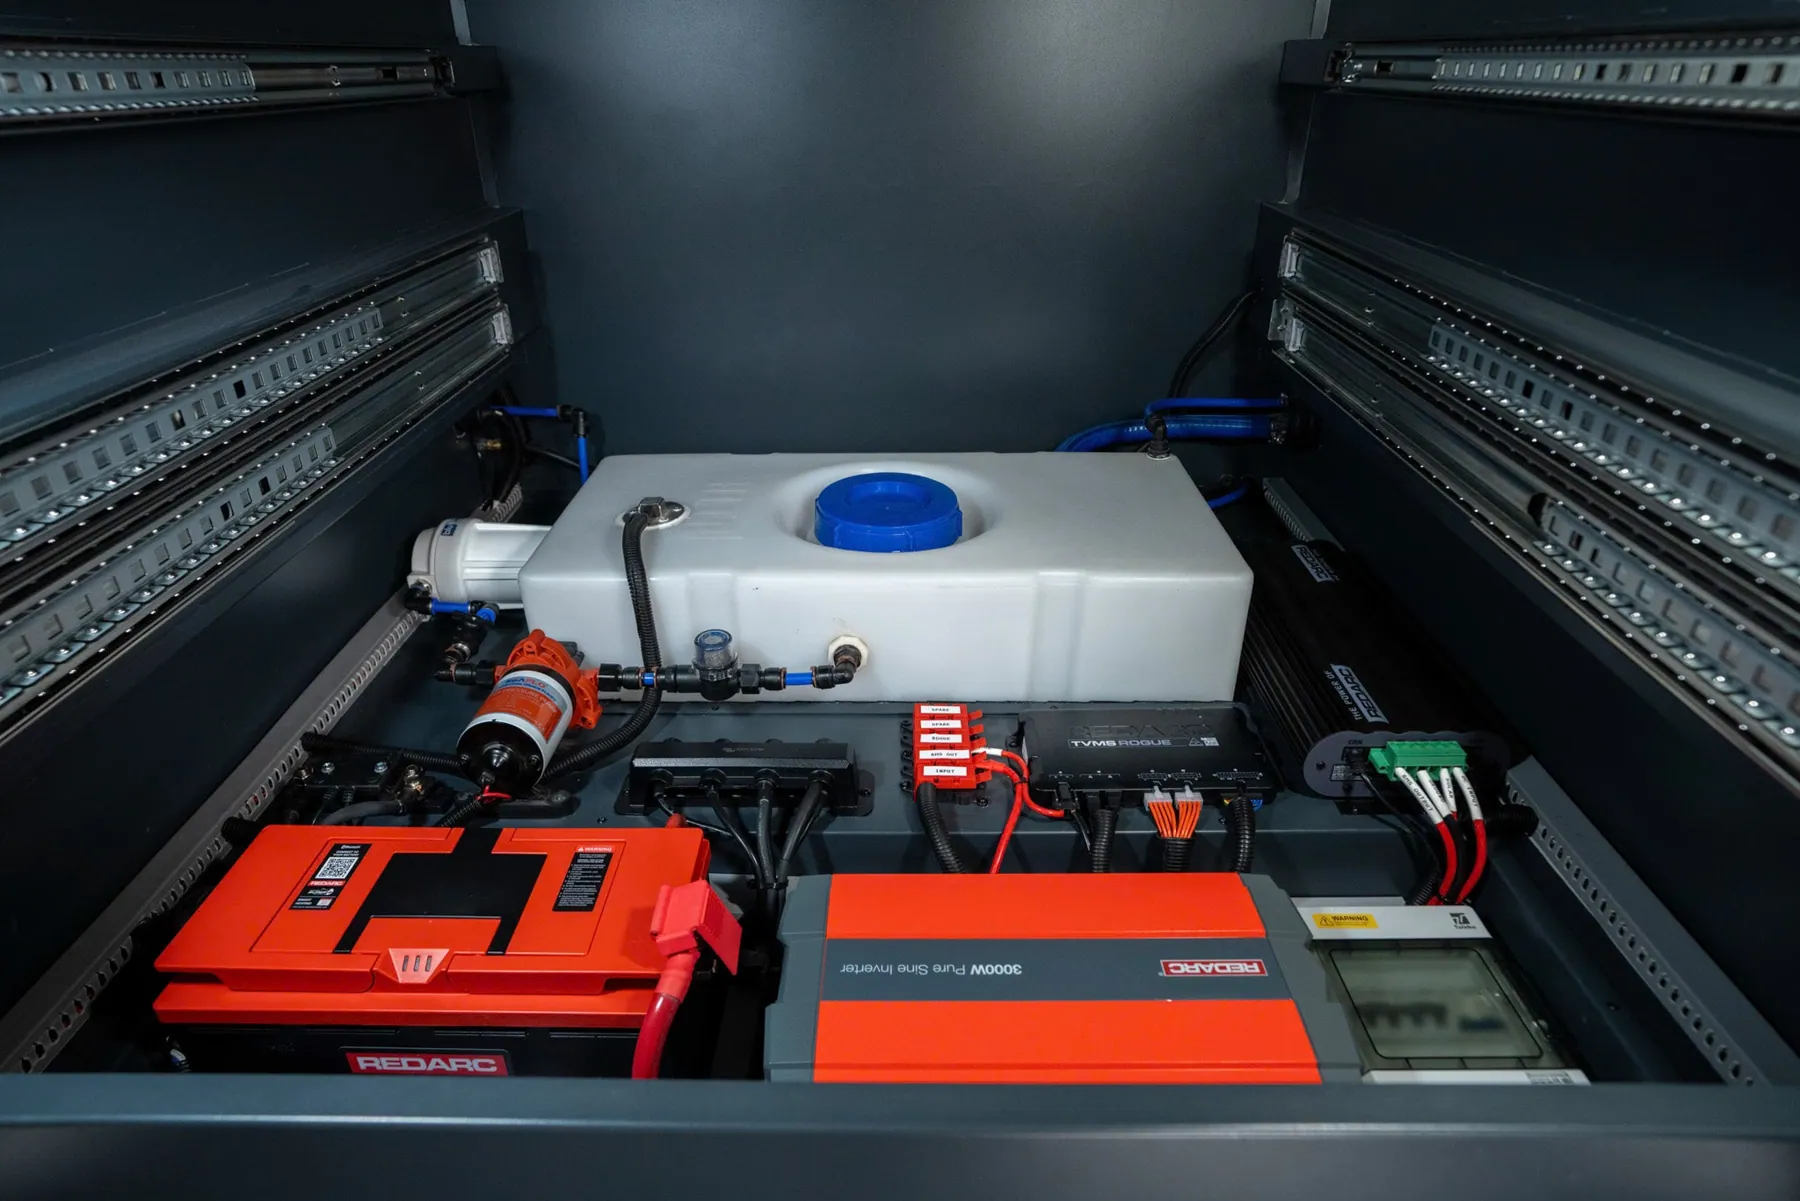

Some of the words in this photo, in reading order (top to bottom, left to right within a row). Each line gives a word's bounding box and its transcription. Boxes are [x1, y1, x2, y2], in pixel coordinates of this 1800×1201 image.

[1295, 546, 1329, 579] REDARC
[1323, 670, 1335, 679] OF
[1331, 681, 1352, 705] POWER
[1338, 668, 1382, 718] REDARC
[1348, 706, 1363, 720] THE
[1413, 788, 1434, 812] OUTPUT
[1467, 786, 1479, 807] INPUT
[840, 963, 893, 975] Inverter
[897, 963, 929, 975] Sine
[932, 964, 966, 975] Pure
[970, 963, 1023, 975] 3000W
[1168, 962, 1261, 974] REDARC
[355, 1056, 498, 1072] REDARC
